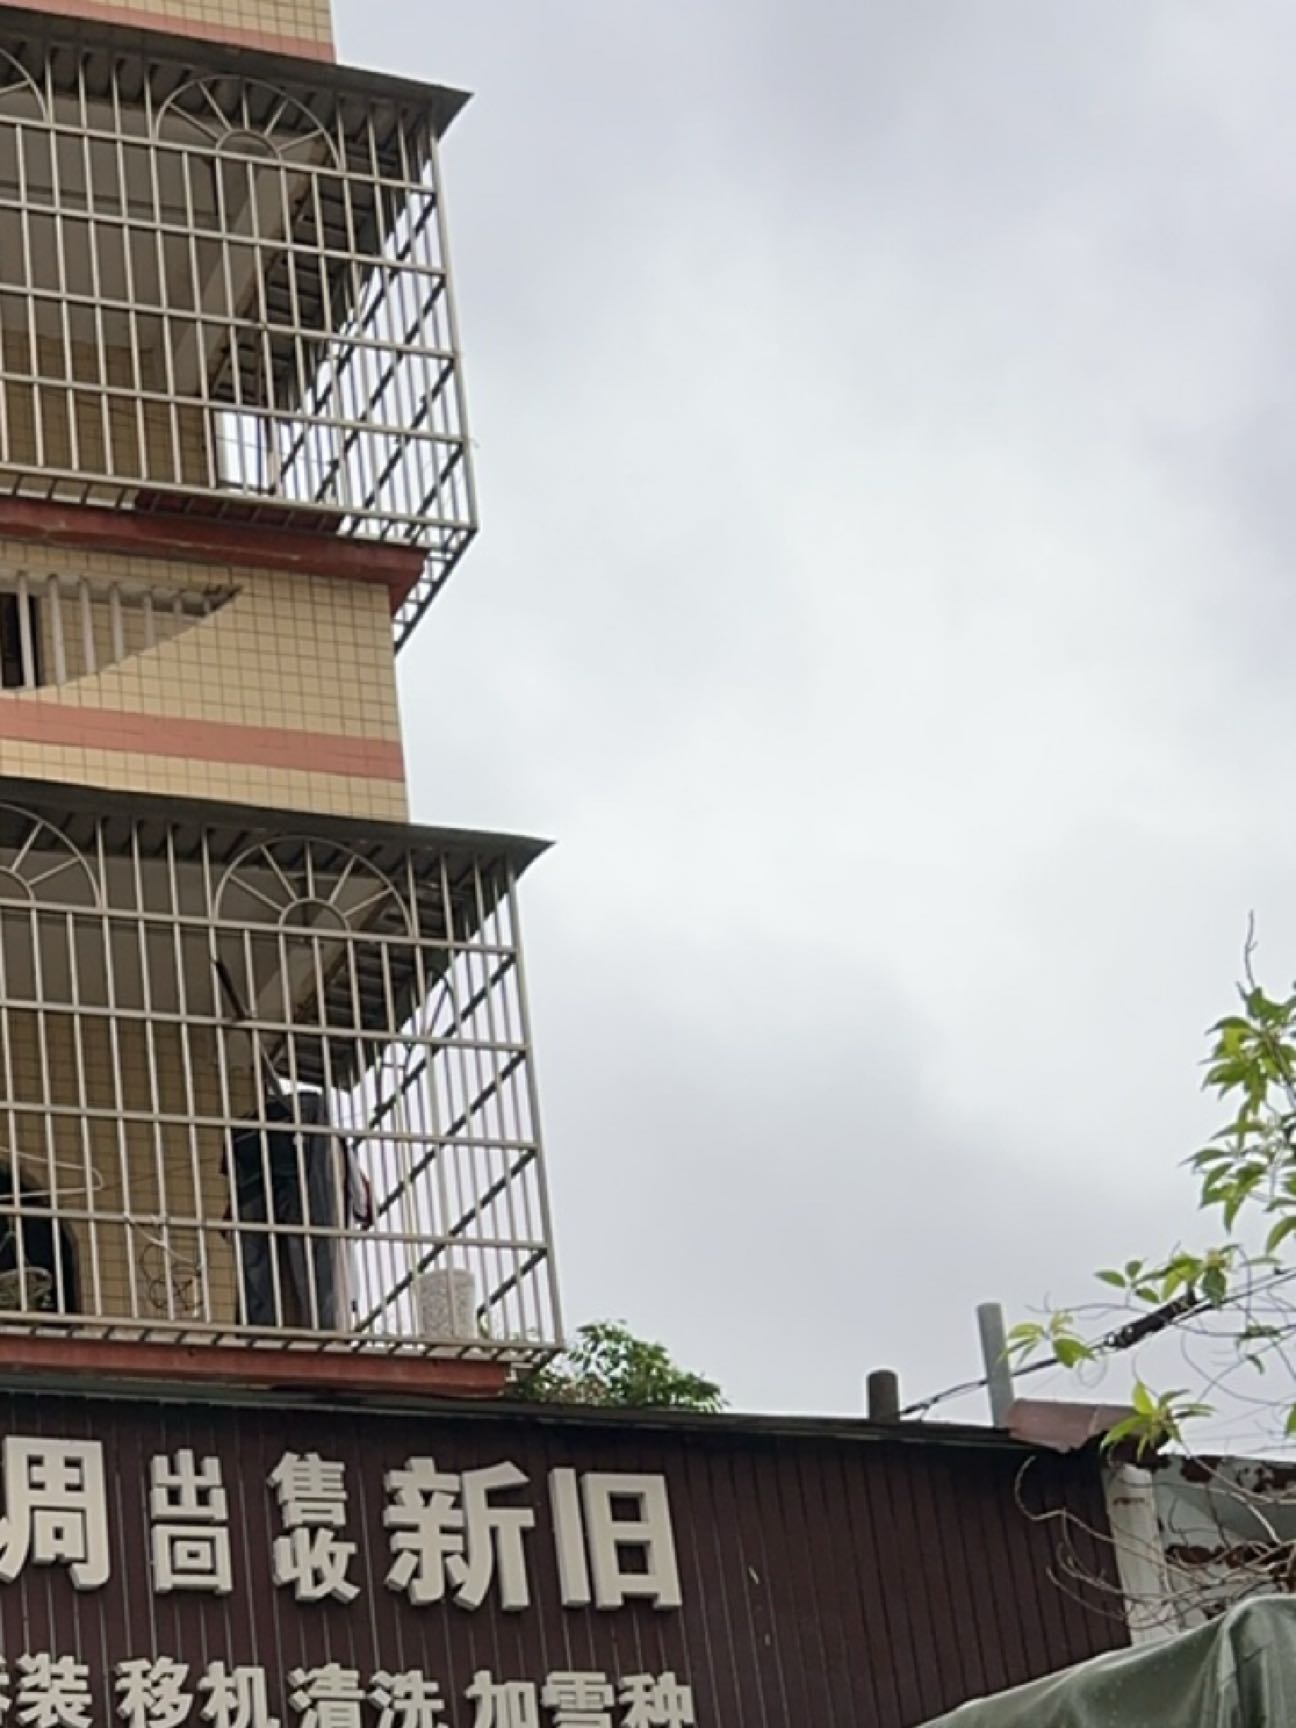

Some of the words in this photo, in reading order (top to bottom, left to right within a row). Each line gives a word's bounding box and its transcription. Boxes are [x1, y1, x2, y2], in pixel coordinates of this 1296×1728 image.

[151, 1448, 348, 1527] 出售
[385, 1457, 683, 1611] 新旧
[152, 1525, 360, 1601] 回收
